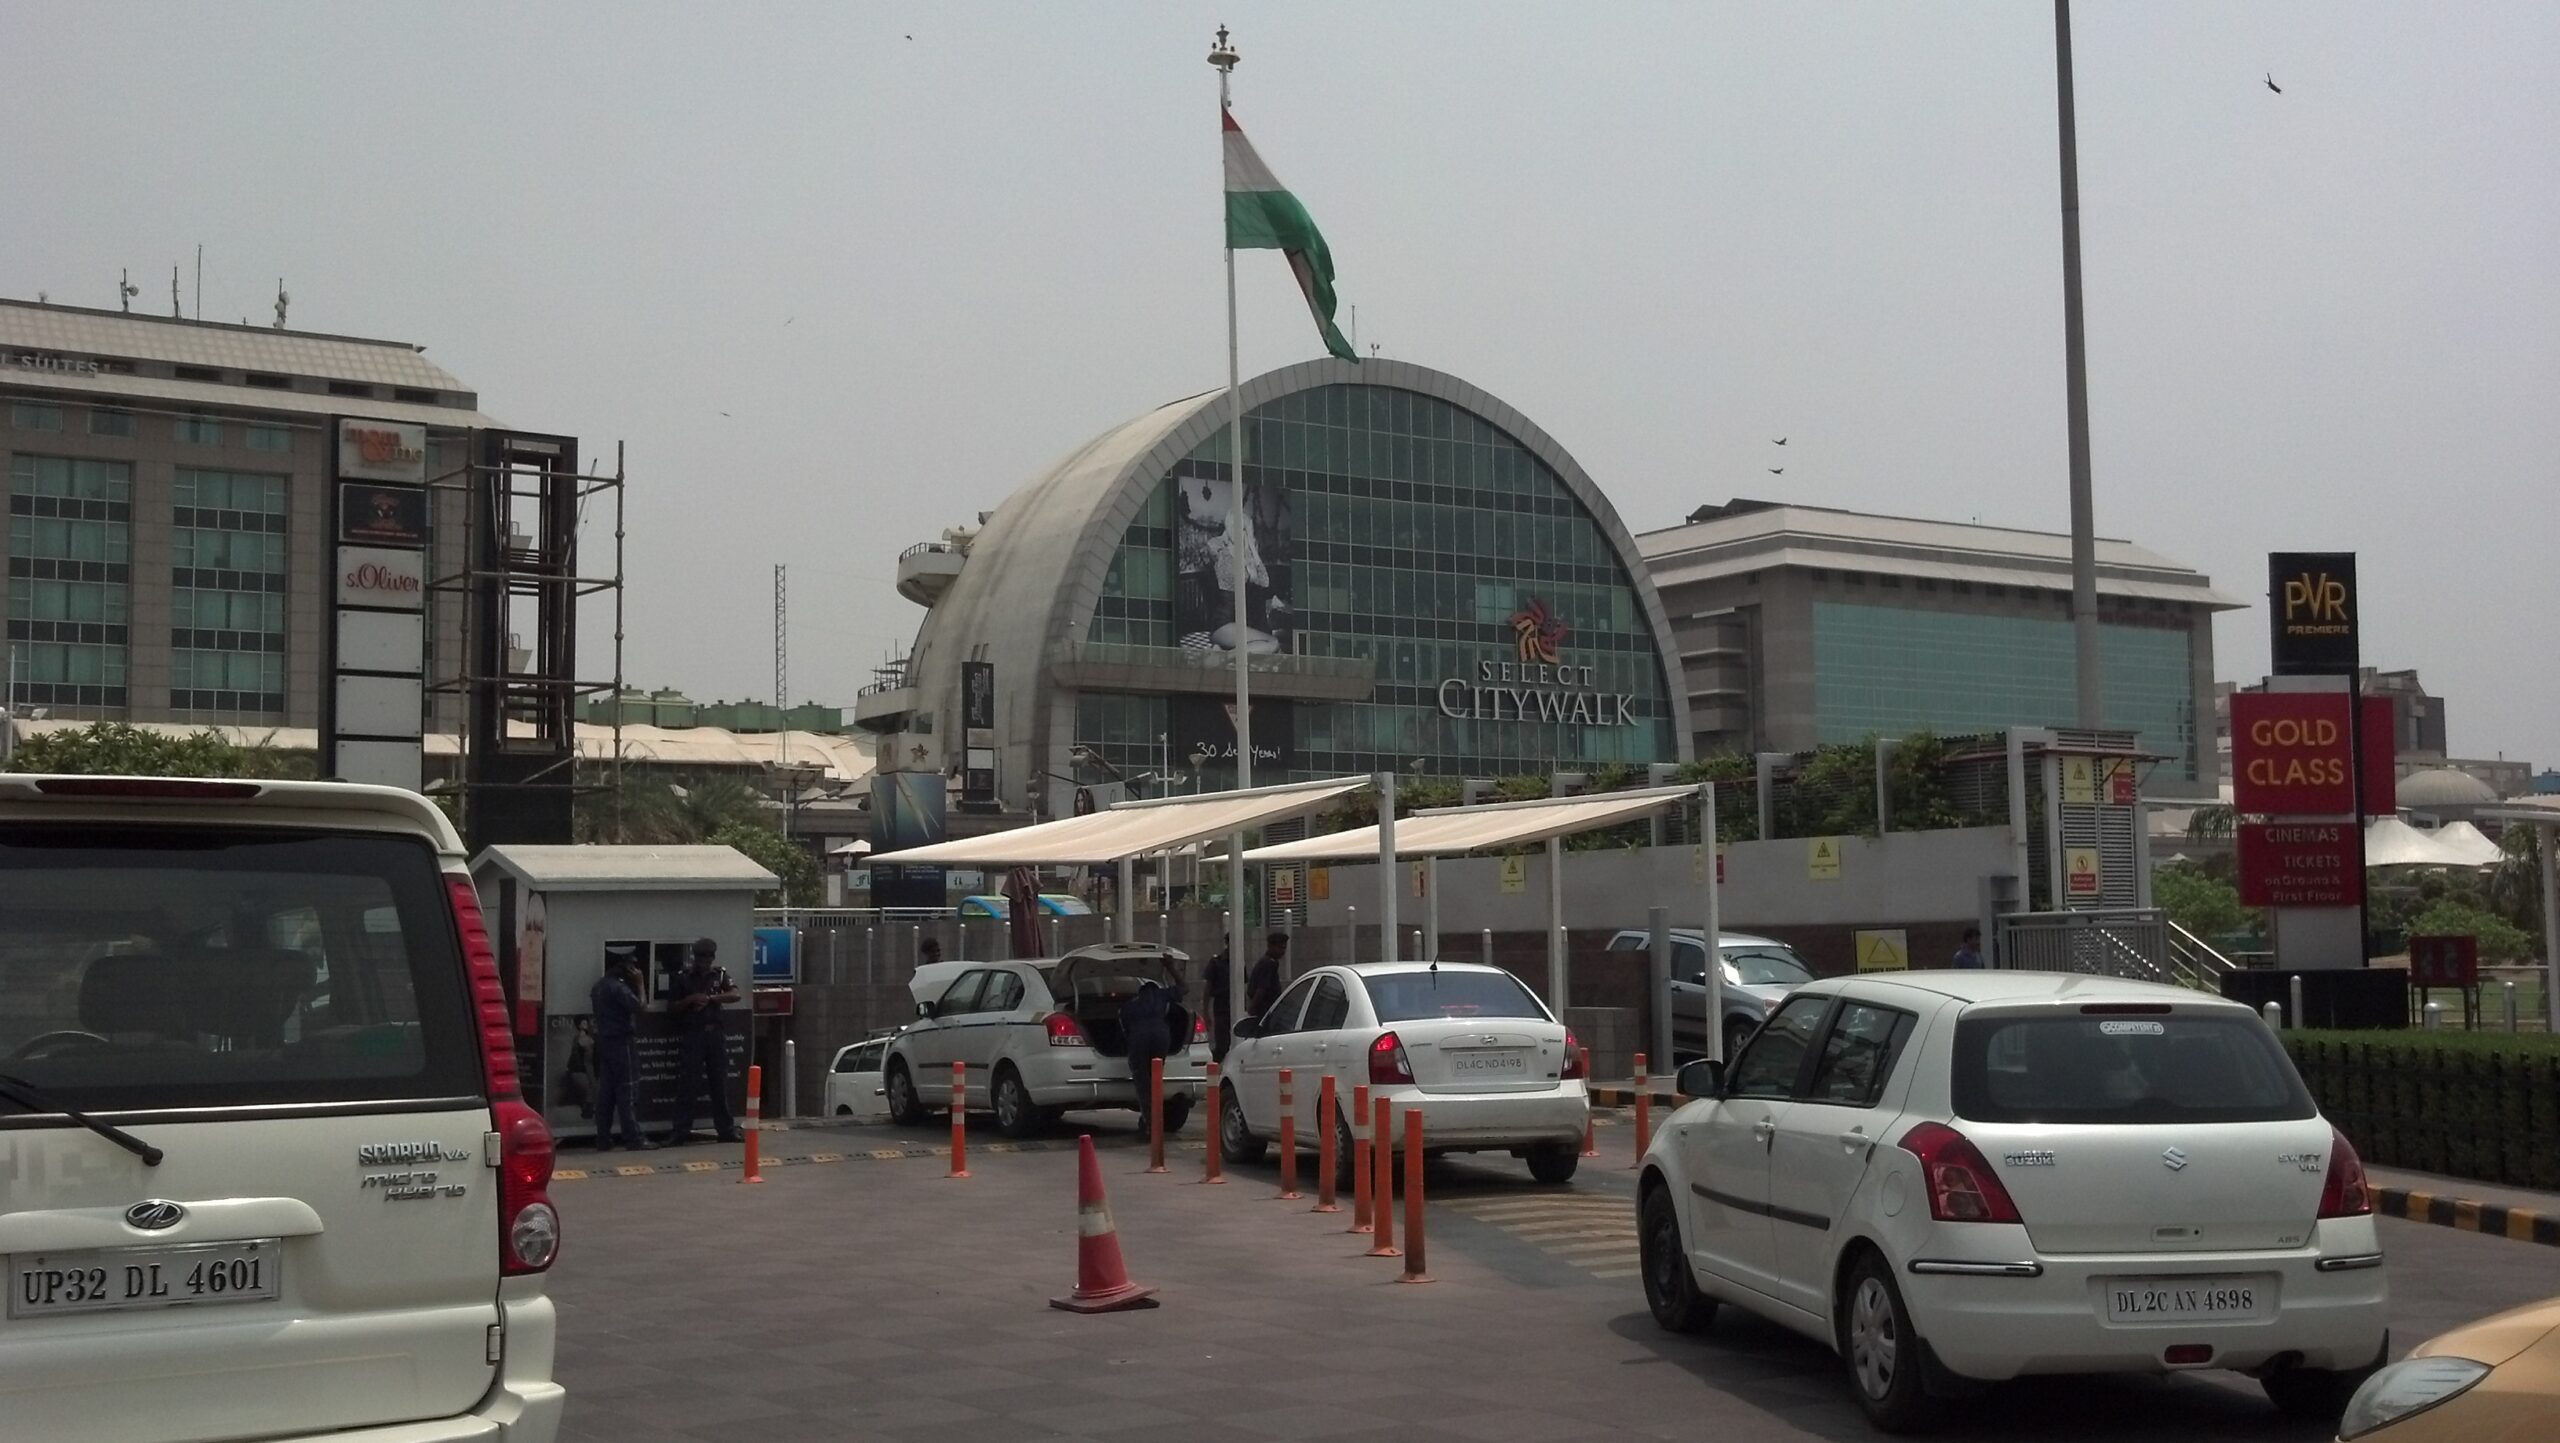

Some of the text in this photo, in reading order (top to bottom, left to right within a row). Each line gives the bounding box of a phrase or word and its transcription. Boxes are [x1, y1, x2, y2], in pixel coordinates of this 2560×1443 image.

[21, 355, 98, 374] SUITES
[346, 563, 420, 592] s.Oliver
[2285, 572, 2348, 620] PVR
[2287, 625, 2350, 634] PREMIERE
[1482, 660, 1592, 687] SELECT
[1439, 678, 1639, 727] CITYWALK
[2251, 719, 2337, 746] GOLD
[2247, 758, 2344, 785] CLASS
[2265, 828, 2339, 842] CINEMAS
[2284, 855, 2341, 868] TICKETS
[2273, 890, 2342, 901] First Floor
[359, 1140, 441, 1166] SCORPIO
[2005, 1157, 2055, 1167] SUZUKI
[2278, 1153, 2321, 1163] SWIFT
[2277, 1236, 2300, 1244] ABS
[23, 1256, 263, 1304] UP32 DL 4601
[2116, 1288, 2253, 1313] DL 2C AN 4898
